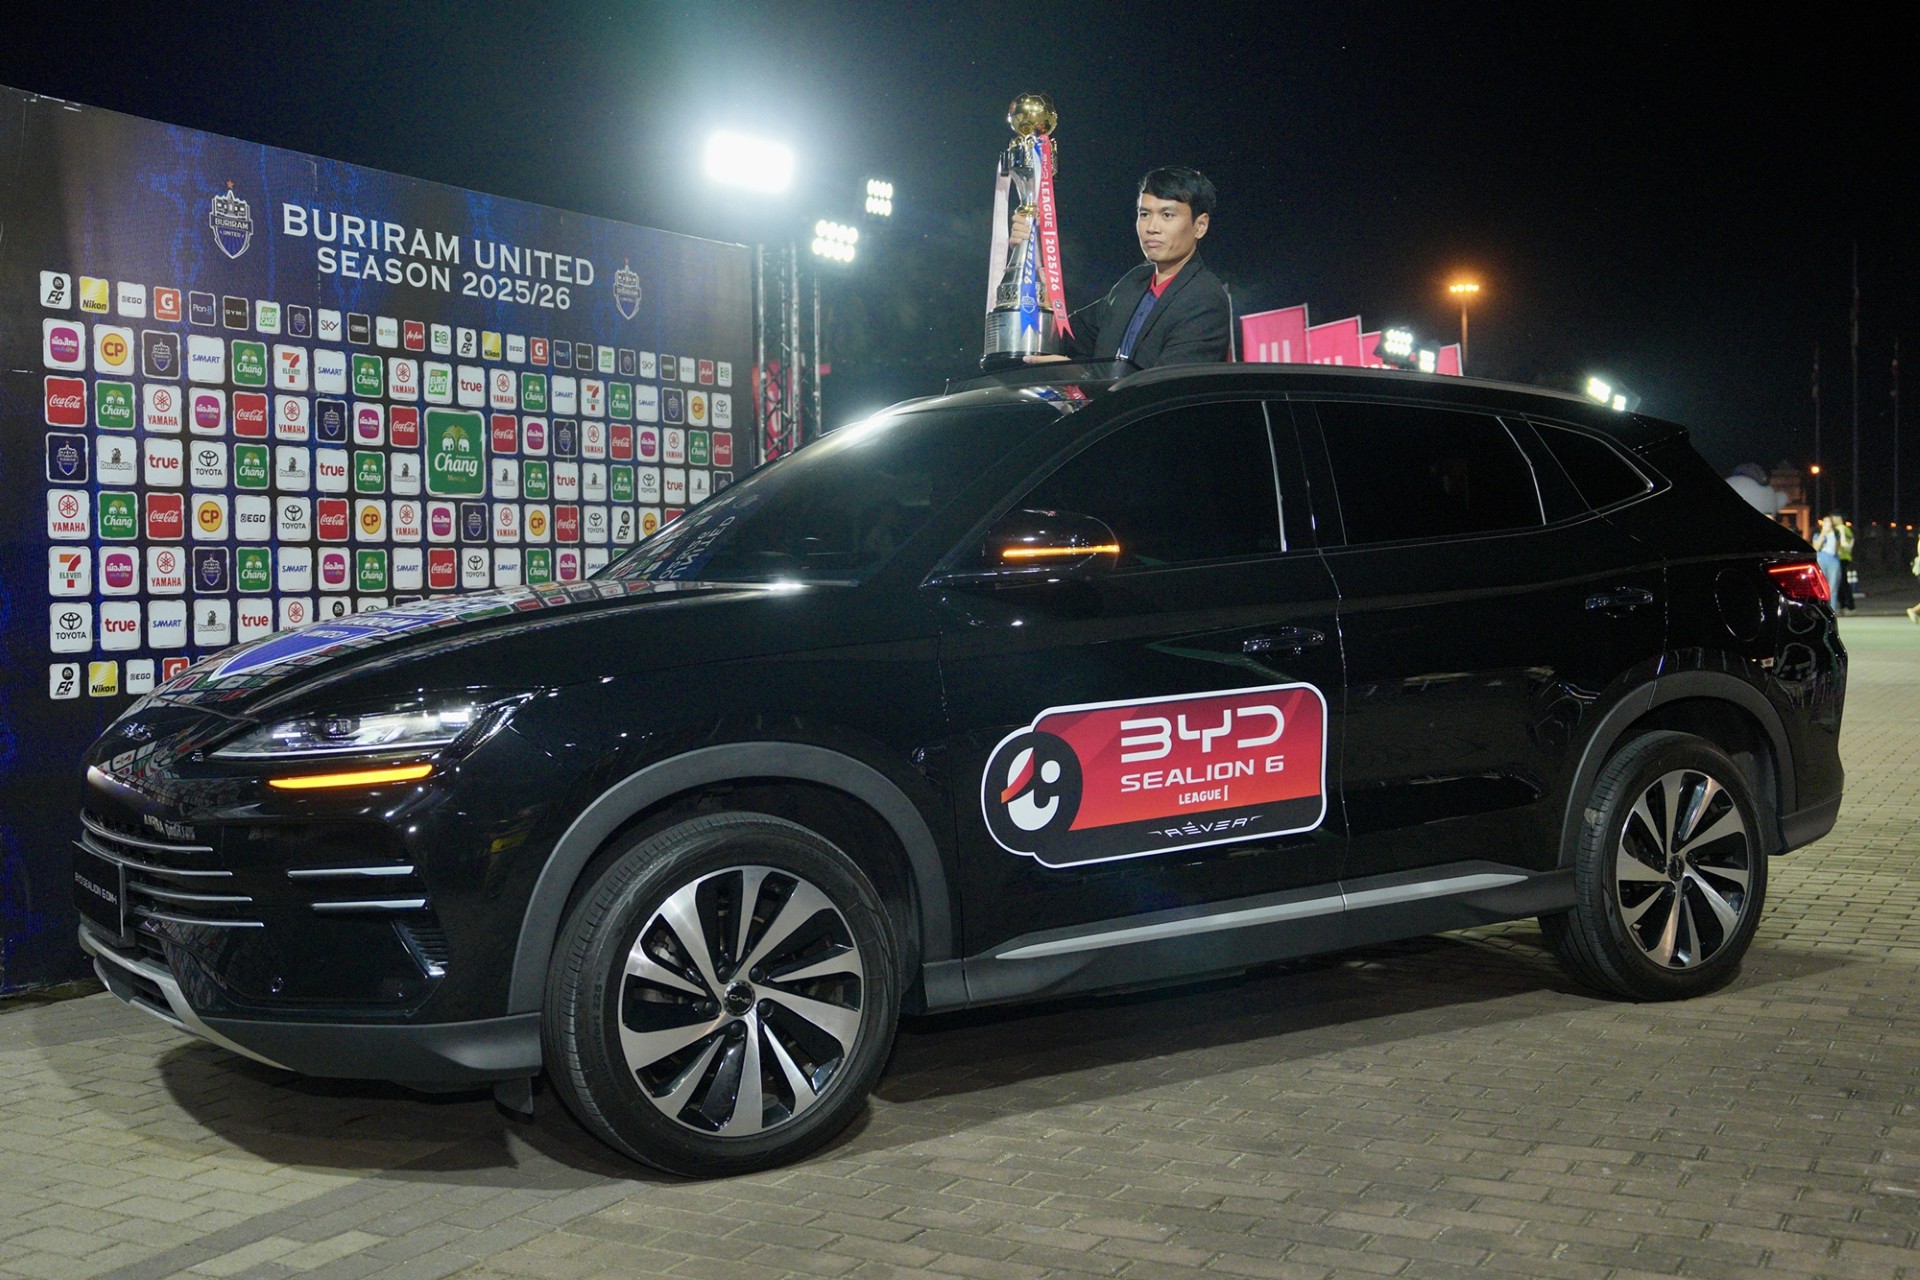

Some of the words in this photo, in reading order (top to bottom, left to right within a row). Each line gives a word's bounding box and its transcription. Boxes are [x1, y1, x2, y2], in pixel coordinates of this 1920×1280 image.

[1041, 181, 1053, 228] LEAGUE
[215, 218, 250, 230] BURIRAM
[282, 202, 461, 265] BURIRAM
[474, 239, 595, 287] UNITED
[1045, 239, 1060, 292] 2025/26
[317, 246, 451, 293] SEASON
[462, 270, 571, 311] 2025/26
[48, 290, 65, 302] FC
[161, 293, 174, 310] G
[82, 299, 107, 311] Nikon
[103, 342, 125, 357] CP
[535, 343, 544, 356] G
[192, 355, 221, 365] SAMART
[237, 362, 263, 376] Chang
[318, 367, 343, 377] SAMART
[356, 374, 380, 388] Chang
[461, 379, 482, 393] true
[392, 385, 416, 395] YAMAHA
[554, 391, 574, 399] SAMART
[493, 395, 514, 404] YAMAHA
[525, 391, 544, 404] Chang
[101, 404, 130, 419] Chang
[612, 400, 630, 411] Chang
[148, 415, 179, 427] YAMAHA
[279, 424, 306, 435] YAMAHA
[584, 445, 604, 454] YAMAHA
[149, 454, 179, 469] true
[434, 452, 479, 478] Chang
[195, 468, 223, 476] TOYOTA
[239, 466, 265, 479] Chang
[319, 463, 345, 477] true
[359, 472, 381, 484] Chang
[557, 475, 576, 487] true
[527, 480, 546, 491] Chang
[614, 483, 632, 494] Chang
[667, 480, 684, 491] true
[104, 514, 133, 528] Chang
[200, 510, 220, 524] CP
[363, 514, 379, 527] CP
[531, 517, 544, 529] CP
[52, 522, 86, 533] YAMAHA
[644, 519, 657, 530] CP
[395, 527, 419, 536] YAMAHA
[496, 529, 518, 537] YAMAHA
[617, 525, 631, 538] FC
[59, 554, 82, 589] 7
[241, 569, 267, 581] Chang
[282, 565, 308, 573] SAMART
[361, 569, 384, 581] Chang
[529, 567, 549, 578] Chang
[151, 577, 182, 588] YAMAHA
[105, 618, 136, 633] true
[153, 619, 183, 628] SAMART
[241, 614, 269, 628] true
[56, 632, 87, 640] TOYOTA
[56, 681, 75, 692] FC
[91, 684, 116, 694] Nikon
[1121, 704, 1285, 763] BYD
[1121, 759, 1254, 792] SEALION
[1265, 755, 1285, 773] 6
[1178, 788, 1222, 805] LEAGUE
